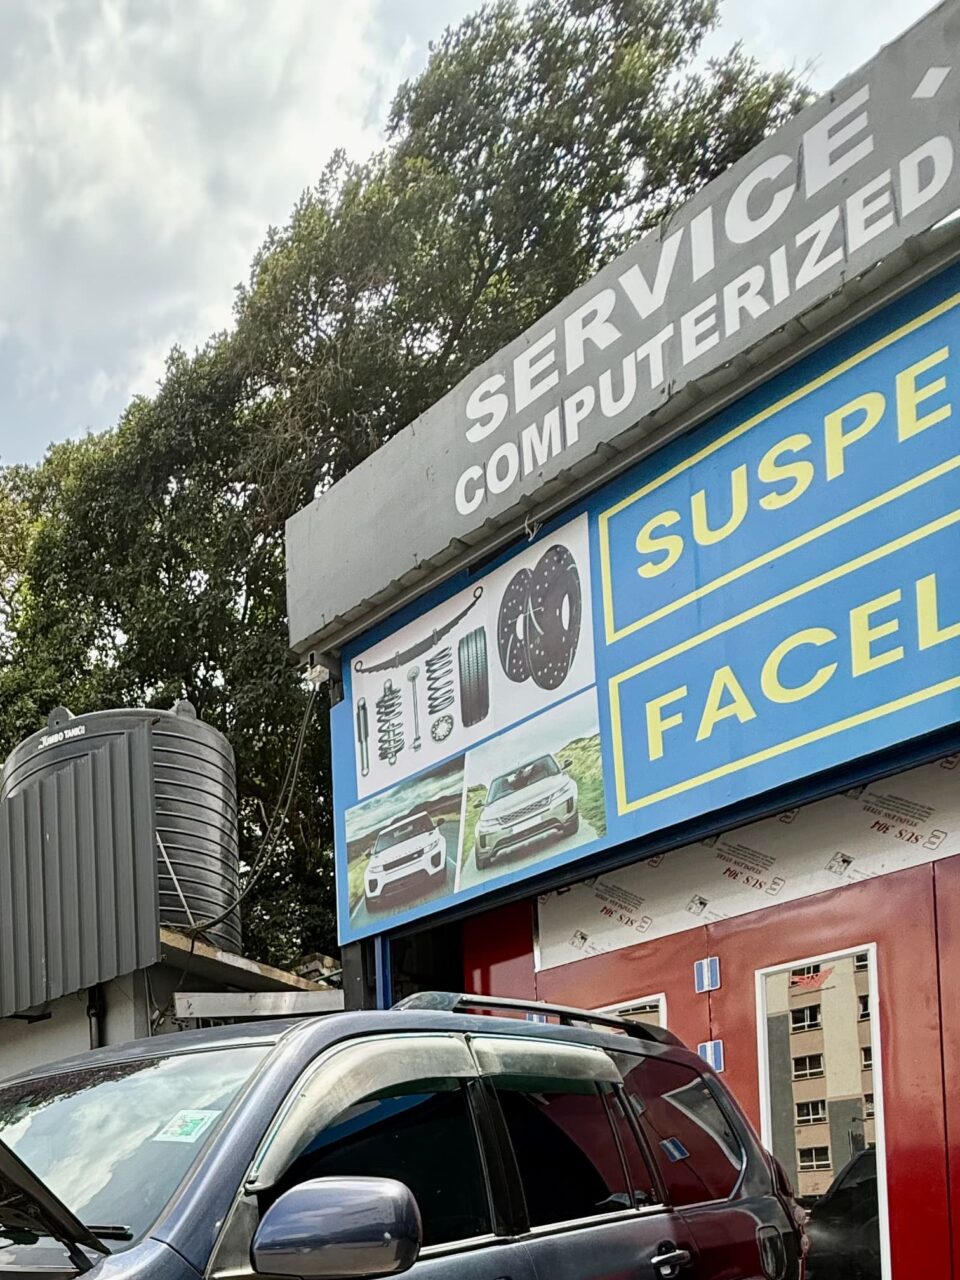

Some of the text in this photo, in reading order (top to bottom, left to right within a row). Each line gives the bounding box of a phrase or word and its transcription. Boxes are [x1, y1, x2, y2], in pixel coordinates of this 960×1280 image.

[454, 135, 954, 516] COMPUTERIZED
[464, 84, 874, 444] SERVICE
[634, 346, 952, 578] SUSPE
[645, 572, 960, 761] FACEL
[722, 866, 767, 890] SUS 304
[870, 819, 924, 845] SUS 304
